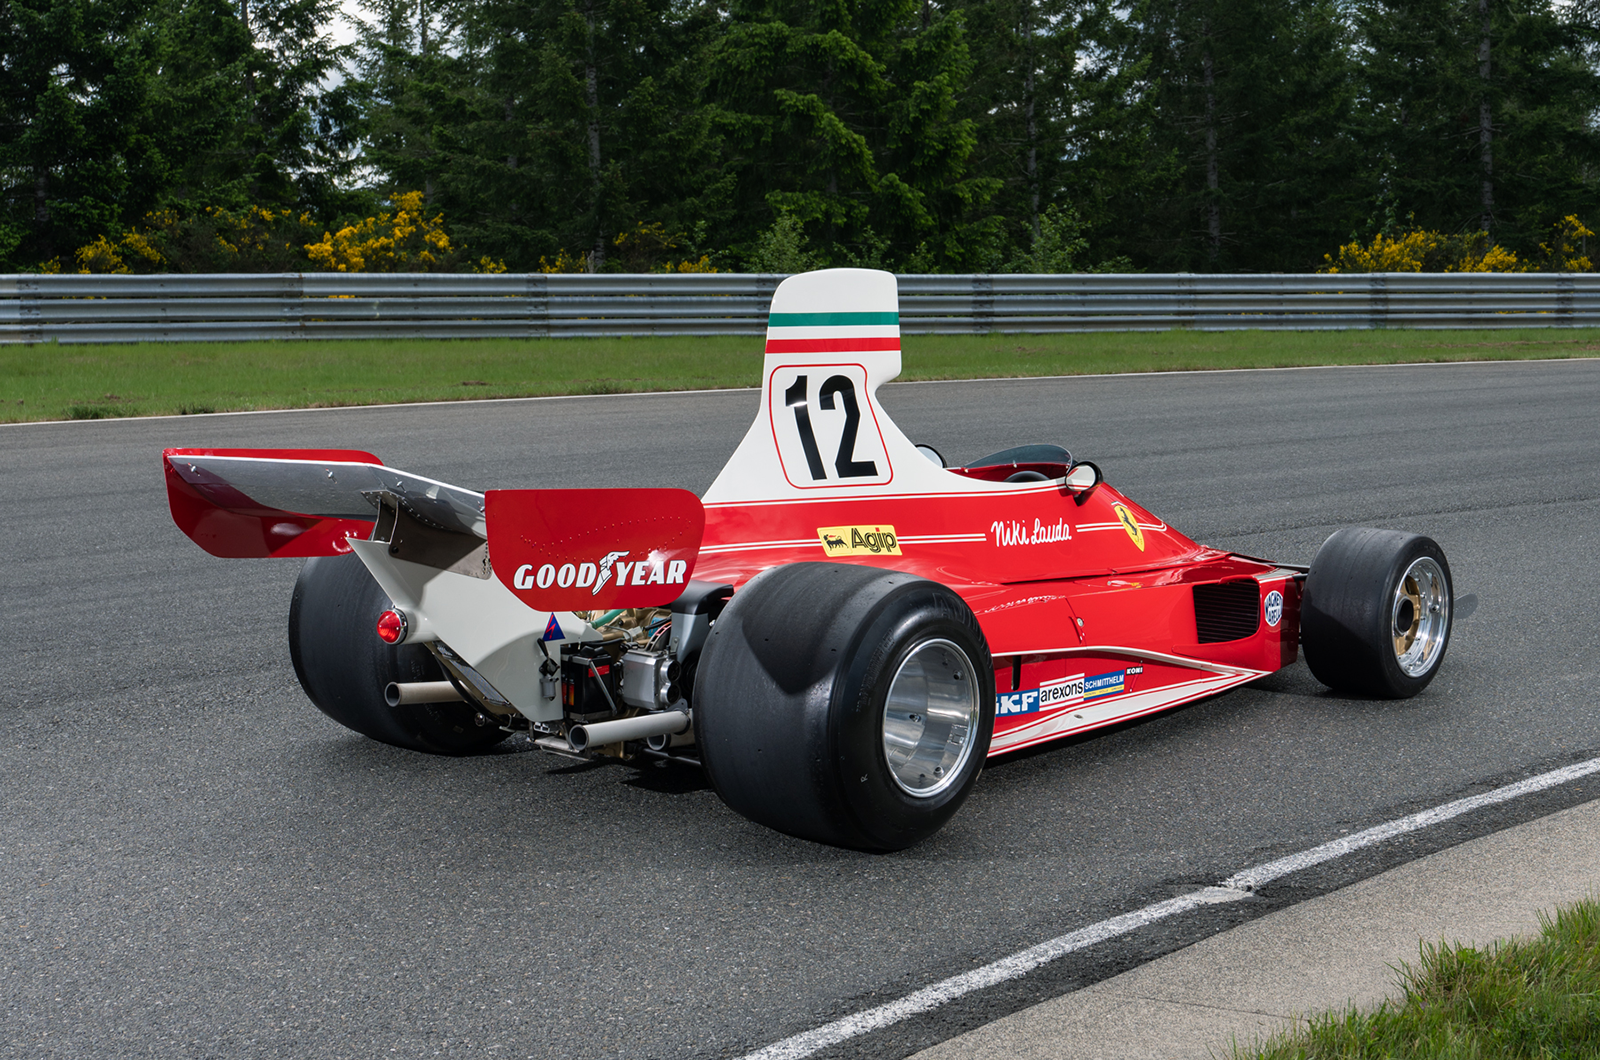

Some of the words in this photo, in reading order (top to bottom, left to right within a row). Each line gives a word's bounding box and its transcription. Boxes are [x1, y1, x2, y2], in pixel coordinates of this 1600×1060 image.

[785, 374, 879, 480] 12
[851, 527, 897, 553] Agip
[991, 520, 1029, 547] Niki
[1031, 517, 1072, 545] Lauda
[1126, 667, 1143, 675] KONI
[996, 690, 1039, 715] KF
[1041, 682, 1084, 702] arexons
